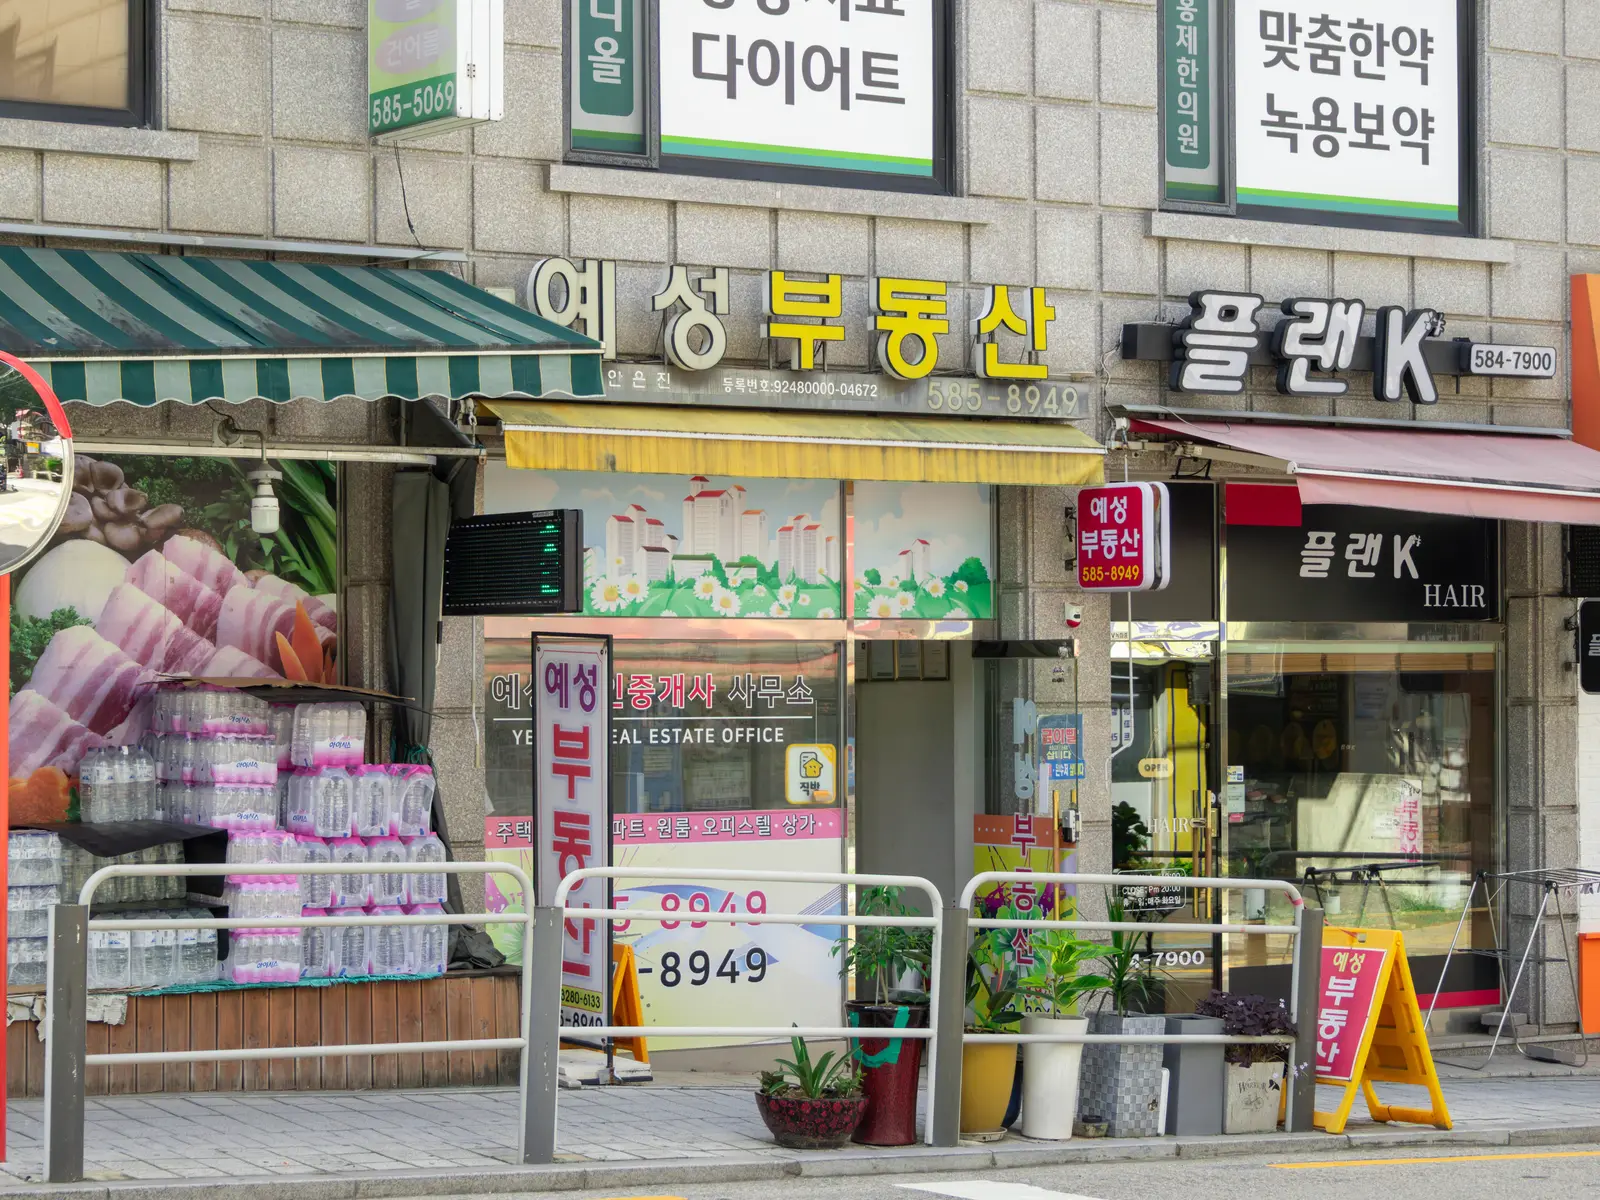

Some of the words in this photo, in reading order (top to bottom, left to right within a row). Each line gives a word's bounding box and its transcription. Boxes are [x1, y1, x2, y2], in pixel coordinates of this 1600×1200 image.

[1259, 9, 1434, 86] 맞춤한약
[692, 31, 906, 111] 다이어트
[372, 80, 455, 128] 585-5069
[1260, 92, 1435, 166] 녹용보약
[529, 257, 731, 372] 예성
[760, 269, 1057, 381] 부동산
[1474, 348, 1553, 371] 584-7900
[927, 379, 1079, 415] 585-8949
[1090, 495, 1128, 525] 예성
[1081, 527, 1141, 560] 부동산
[1082, 564, 1140, 582] 585-8949
[1423, 583, 1487, 608] HAIR
[491, 672, 533, 709] 예
[727, 672, 814, 708] 사무소
[544, 661, 598, 713] 예성
[649, 728, 715, 744] ESTATE
[721, 727, 784, 743] OFFICE
[656, 816, 691, 839] 원룸
[701, 814, 772, 837] 오피스텔
[781, 813, 816, 836] 상가
[1146, 817, 1189, 834] HAIR
[1332, 951, 1366, 975] 예성
